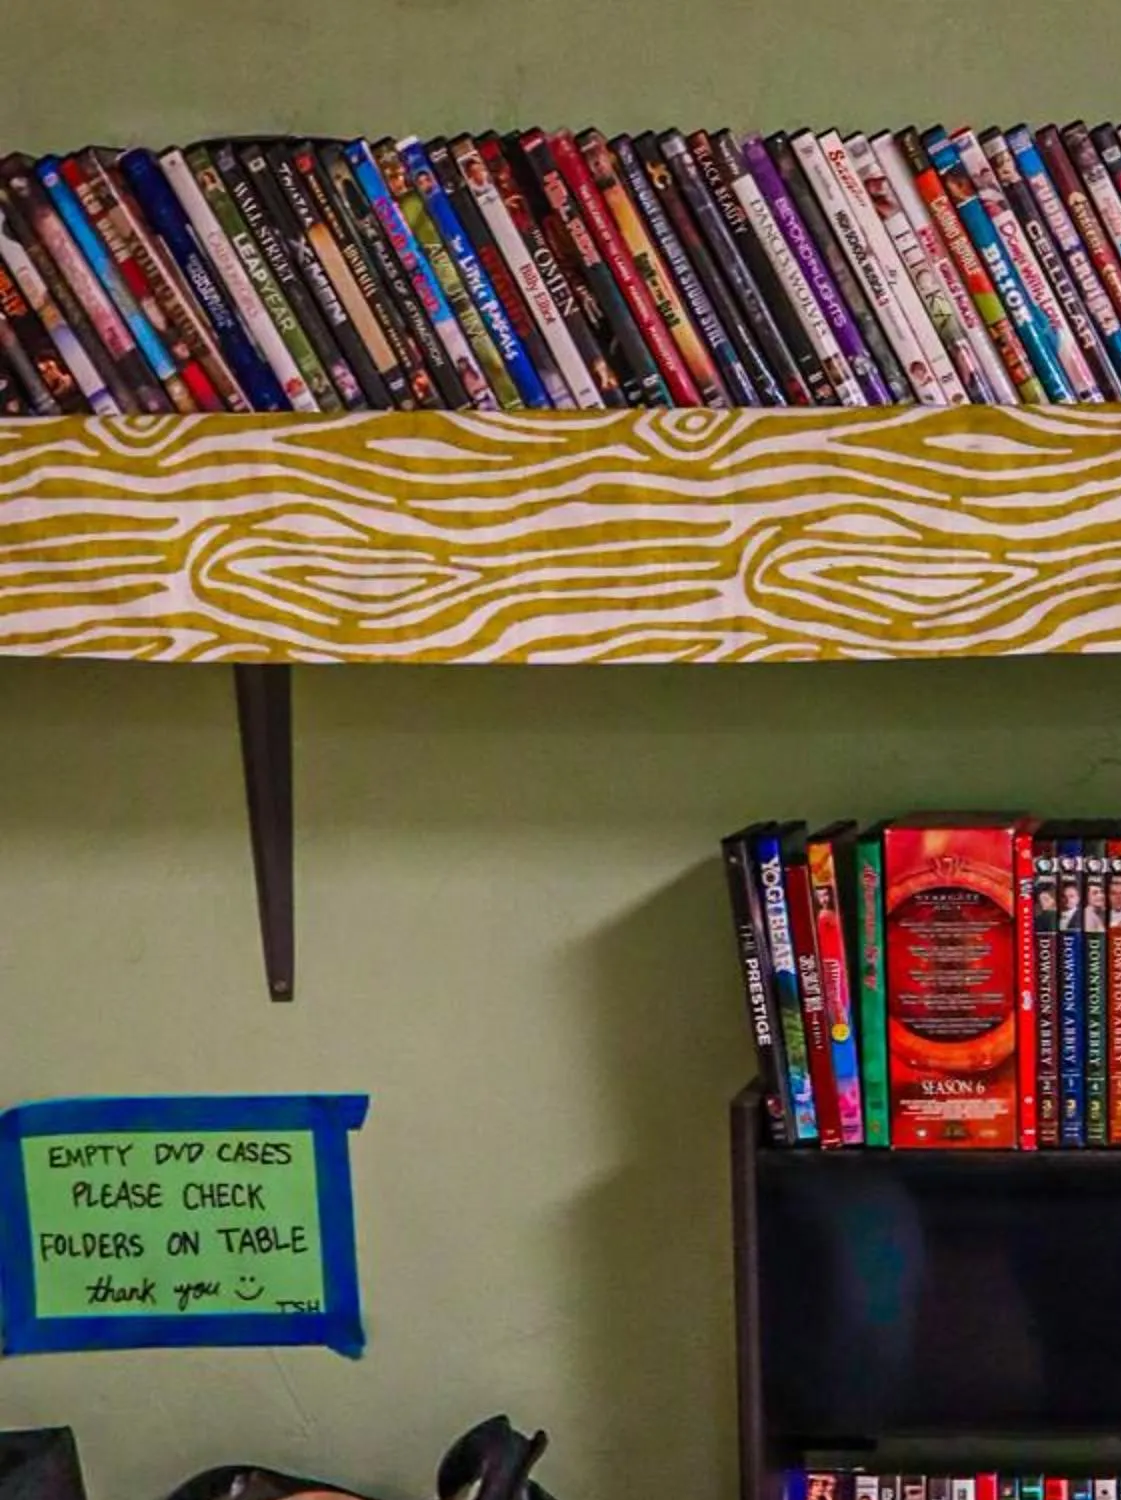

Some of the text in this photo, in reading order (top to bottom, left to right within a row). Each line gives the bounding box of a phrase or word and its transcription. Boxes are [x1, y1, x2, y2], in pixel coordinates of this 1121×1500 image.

[692, 144, 747, 236] BLACK BEAUTY
[771, 195, 814, 260] BEYOND
[1030, 171, 1079, 253] PUDDLE
[230, 181, 264, 226] WALL
[253, 224, 297, 287] STREET
[230, 231, 269, 286] LEAP
[256, 278, 296, 334] YEAR
[531, 245, 580, 319] OMEN
[893, 228, 958, 334] FLICKA
[981, 242, 1032, 328] BRICK
[1025, 218, 1096, 350] CELLULAR
[761, 857, 796, 974] YOGI BEAR
[745, 959, 772, 1046] PRESTIGE
[1039, 939, 1053, 1065] DOWNTON ABBEY
[1063, 936, 1077, 1064] DOWNTON ABBEY
[1088, 939, 1102, 1065] DOWNTON ABBEY
[921, 1079, 986, 1095] SEASON 6
[49, 1142, 292, 1168] EMPTY DVD CASES
[72, 1181, 267, 1210] PLEASE CHECK
[40, 1226, 309, 1261] FOLDERS ON TABLE
[86, 1275, 221, 1311] thank you
